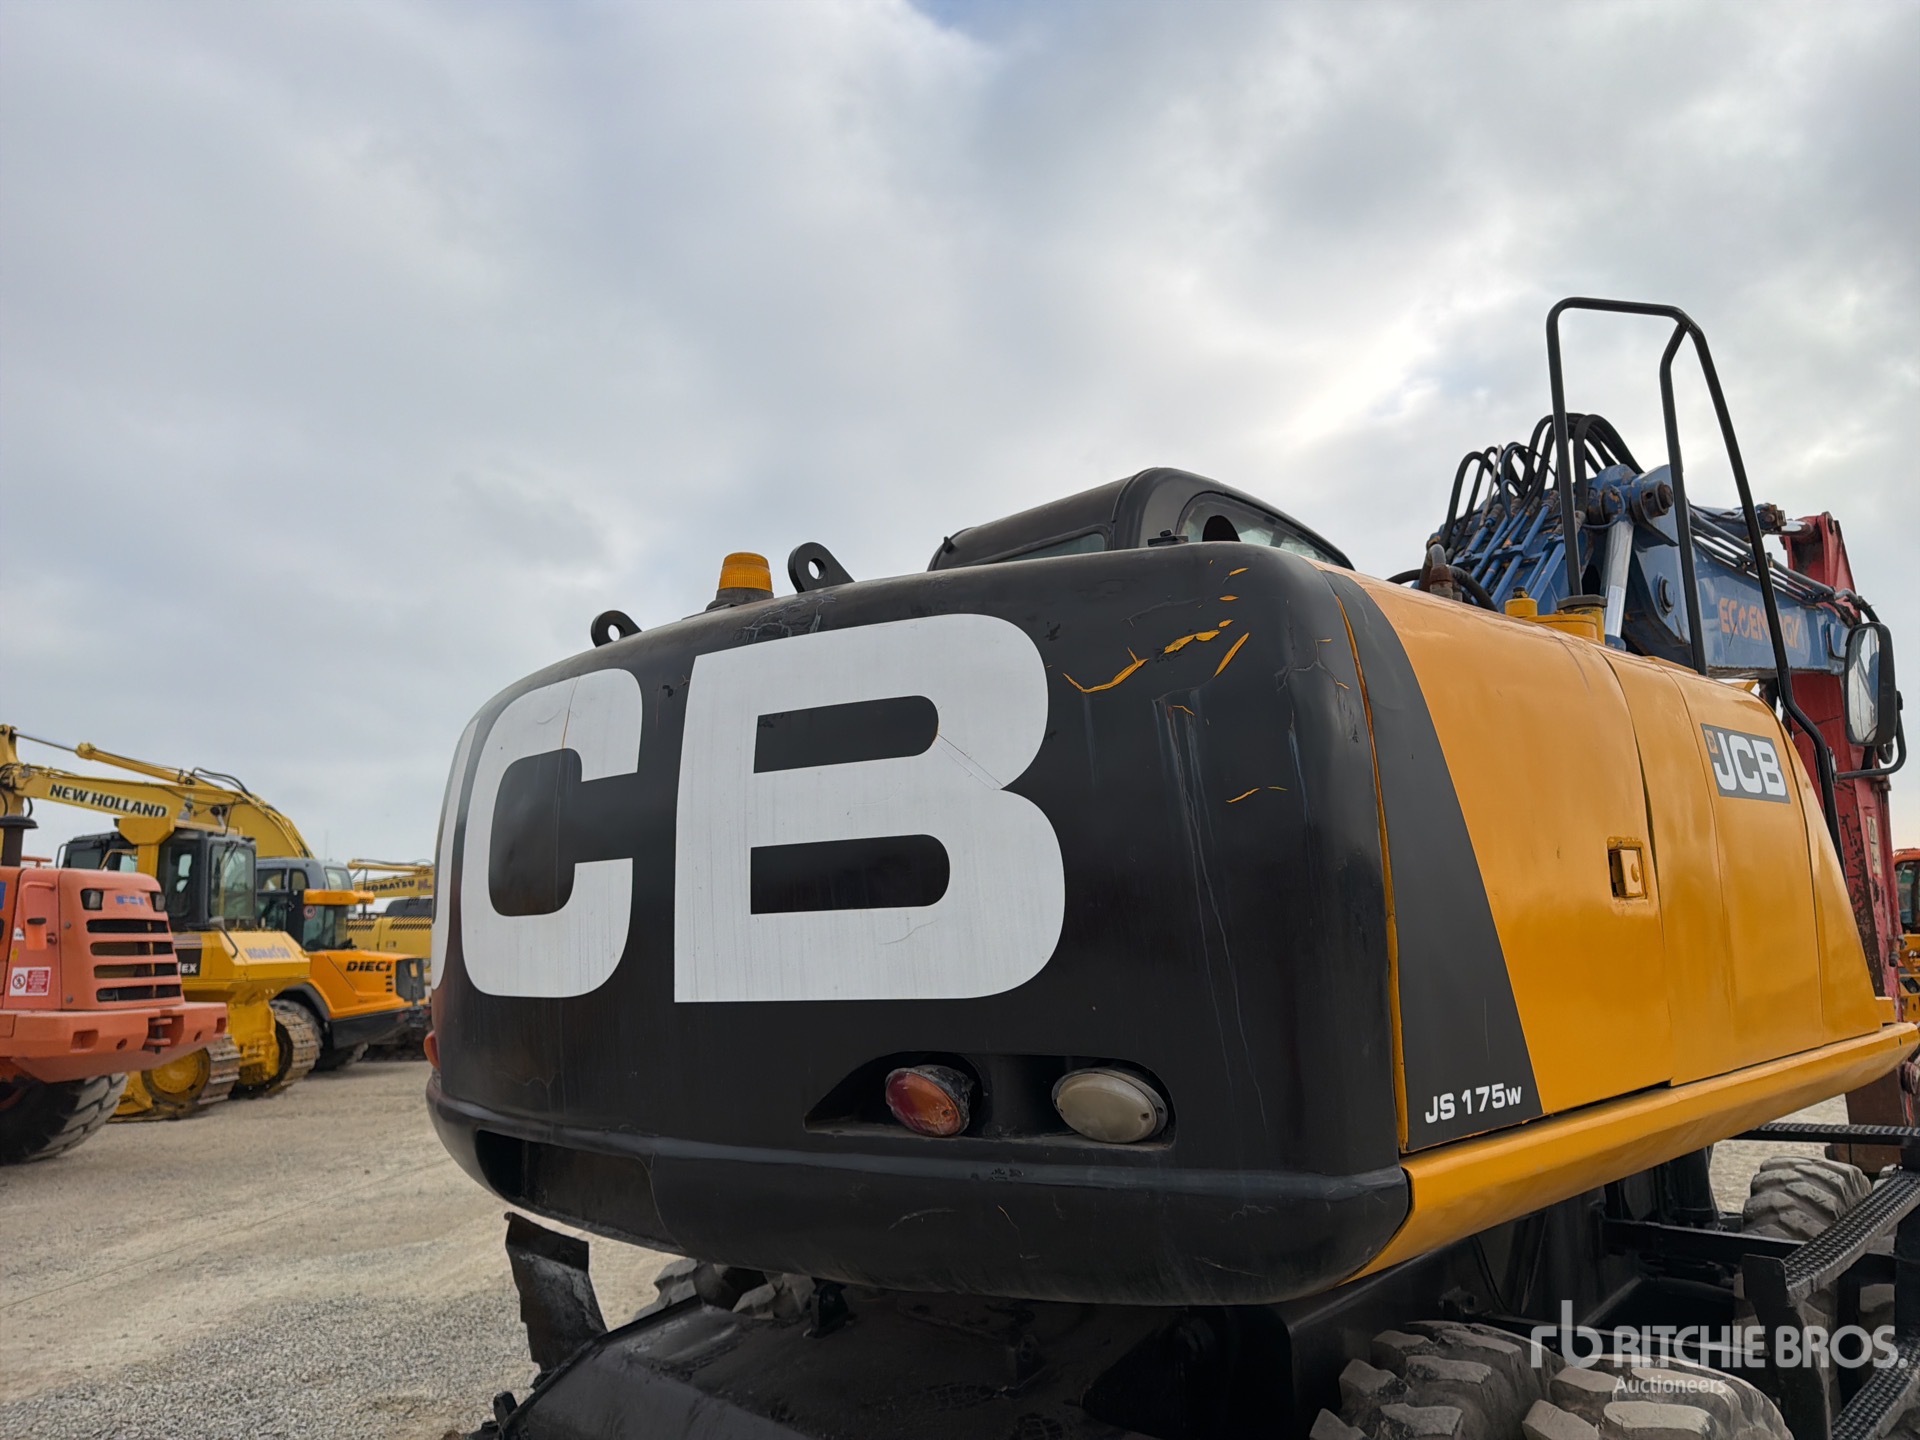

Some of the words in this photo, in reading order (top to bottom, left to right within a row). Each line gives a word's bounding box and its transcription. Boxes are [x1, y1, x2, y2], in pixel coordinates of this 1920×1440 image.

[1719, 597, 1801, 649] ECOENGY
[1713, 732, 1786, 796] JCB
[50, 784, 88, 804] NEW
[90, 793, 167, 818] HOLLAND
[1425, 1092, 1455, 1124] JS
